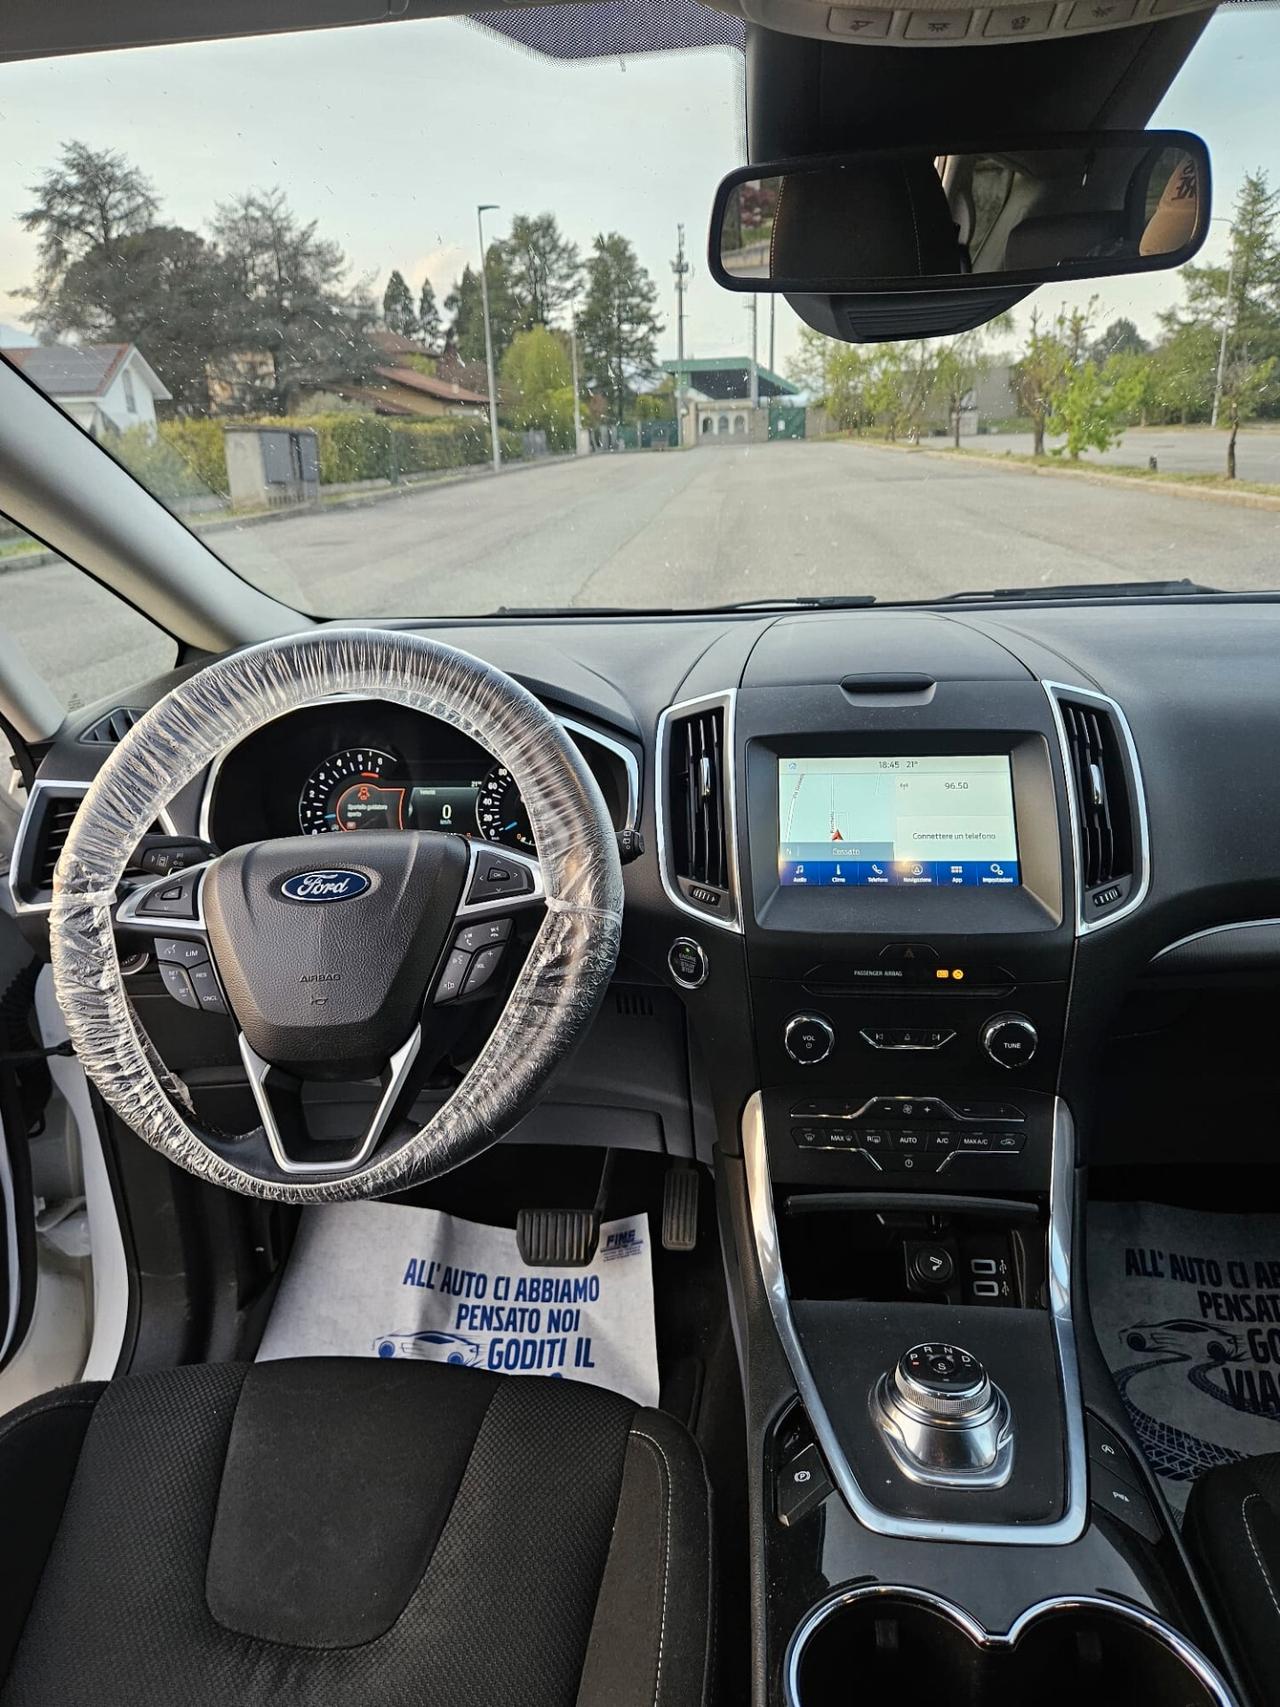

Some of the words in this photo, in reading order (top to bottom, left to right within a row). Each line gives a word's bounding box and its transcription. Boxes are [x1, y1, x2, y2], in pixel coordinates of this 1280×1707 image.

[879, 761, 900, 769] 18:45
[488, 782, 498, 790] 60
[944, 782, 969, 790] 96.50
[309, 790, 315, 798] 2
[483, 798, 492, 806] 40
[442, 804, 452, 819] 0
[483, 814, 493, 822] 20
[912, 832, 953, 840] Connettere
[965, 832, 996, 840] telefono
[297, 873, 351, 896] Ford
[299, 973, 341, 983] AIRBAG
[1003, 1042, 1022, 1050] TUNE
[830, 1134, 845, 1143] MAX
[899, 1136, 918, 1144] AUTO
[936, 1137, 949, 1145] A/C
[963, 1137, 977, 1145] MAX
[977, 1137, 989, 1146] A/C
[1124, 1248, 1165, 1279] ALL'
[1169, 1253, 1223, 1288] AUTO
[1226, 1261, 1250, 1289] CI
[403, 1258, 440, 1290] ALL'
[440, 1266, 488, 1300] AUTO
[493, 1275, 511, 1302] CI
[514, 1274, 601, 1304] ABBIAMO
[455, 1303, 541, 1334] PENSATO
[547, 1308, 581, 1334] NOI
[487, 1337, 568, 1371] GODITI
[574, 1337, 596, 1369] IL
[923, 1346, 933, 1354] R
[909, 1353, 918, 1361] P
[961, 1355, 971, 1363] D
[937, 1362, 947, 1371] S
